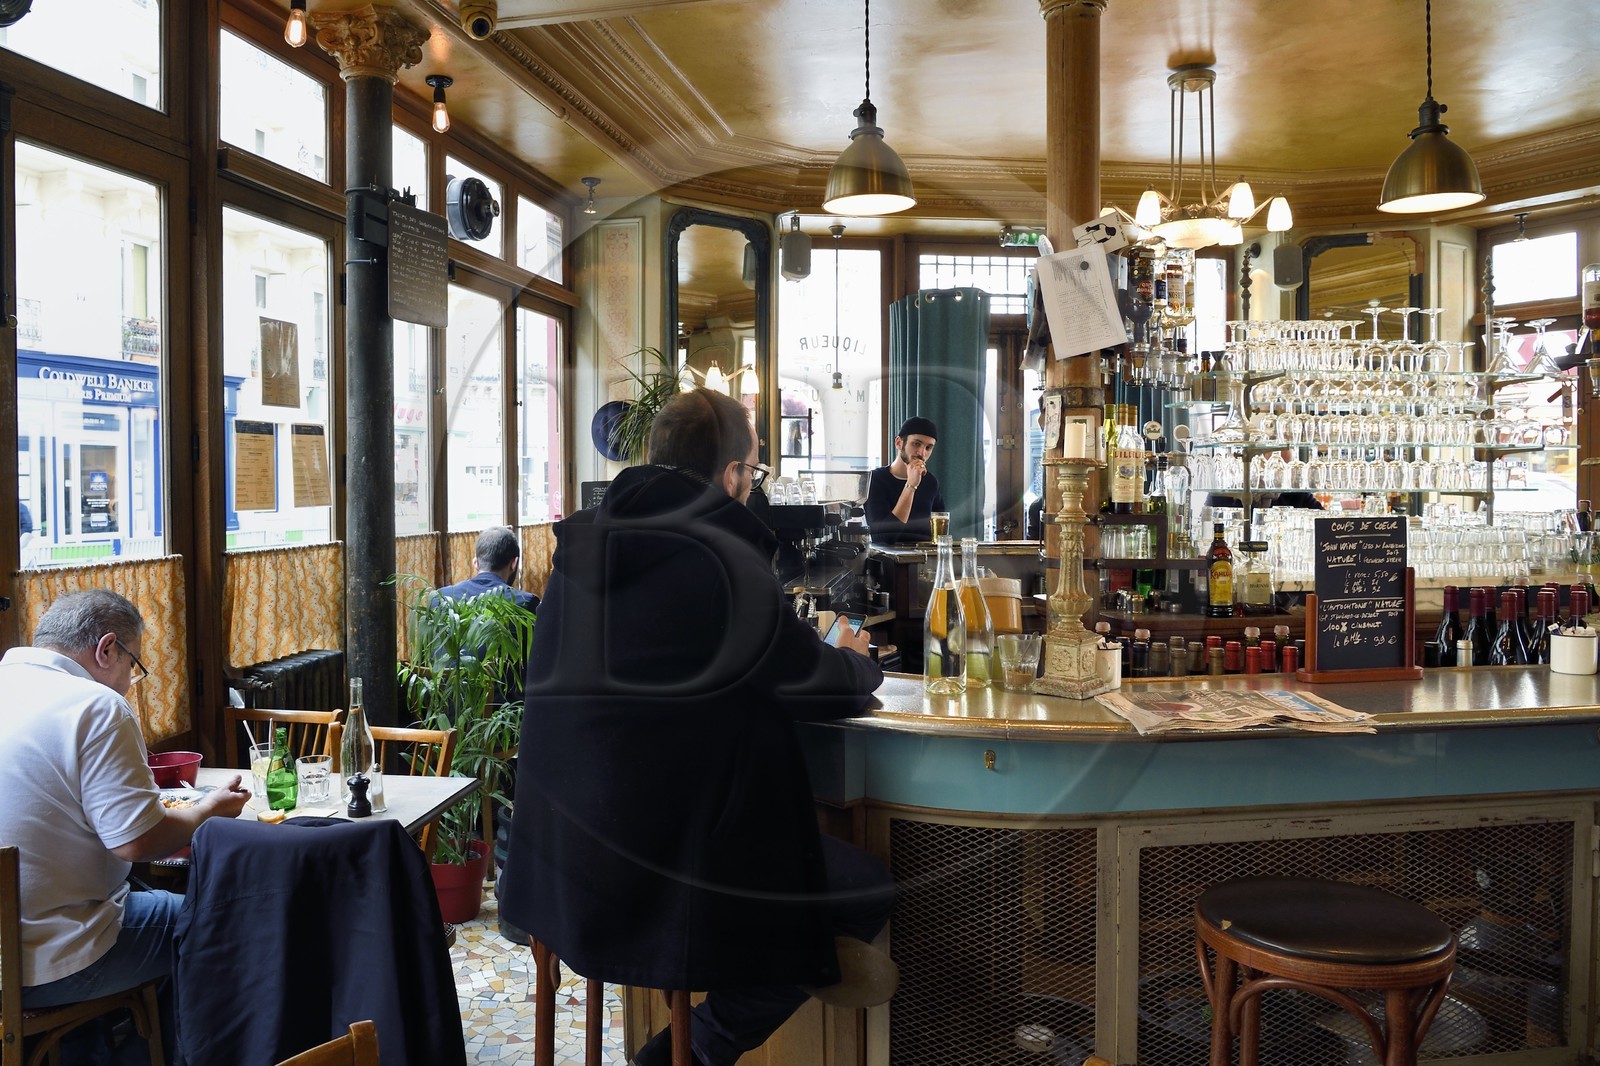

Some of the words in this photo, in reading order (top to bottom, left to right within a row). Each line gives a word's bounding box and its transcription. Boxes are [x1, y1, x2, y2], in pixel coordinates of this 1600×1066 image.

[38, 366, 106, 388] COLDWELL
[107, 373, 155, 393] BANKER
[1359, 521, 1372, 531] DE
[1326, 554, 1357, 563] NATURE
[1374, 569, 1389, 579] 5,50
[1374, 599, 1405, 609] NATURE
[1322, 621, 1349, 633] 100%
[1387, 635, 1398, 645] €
